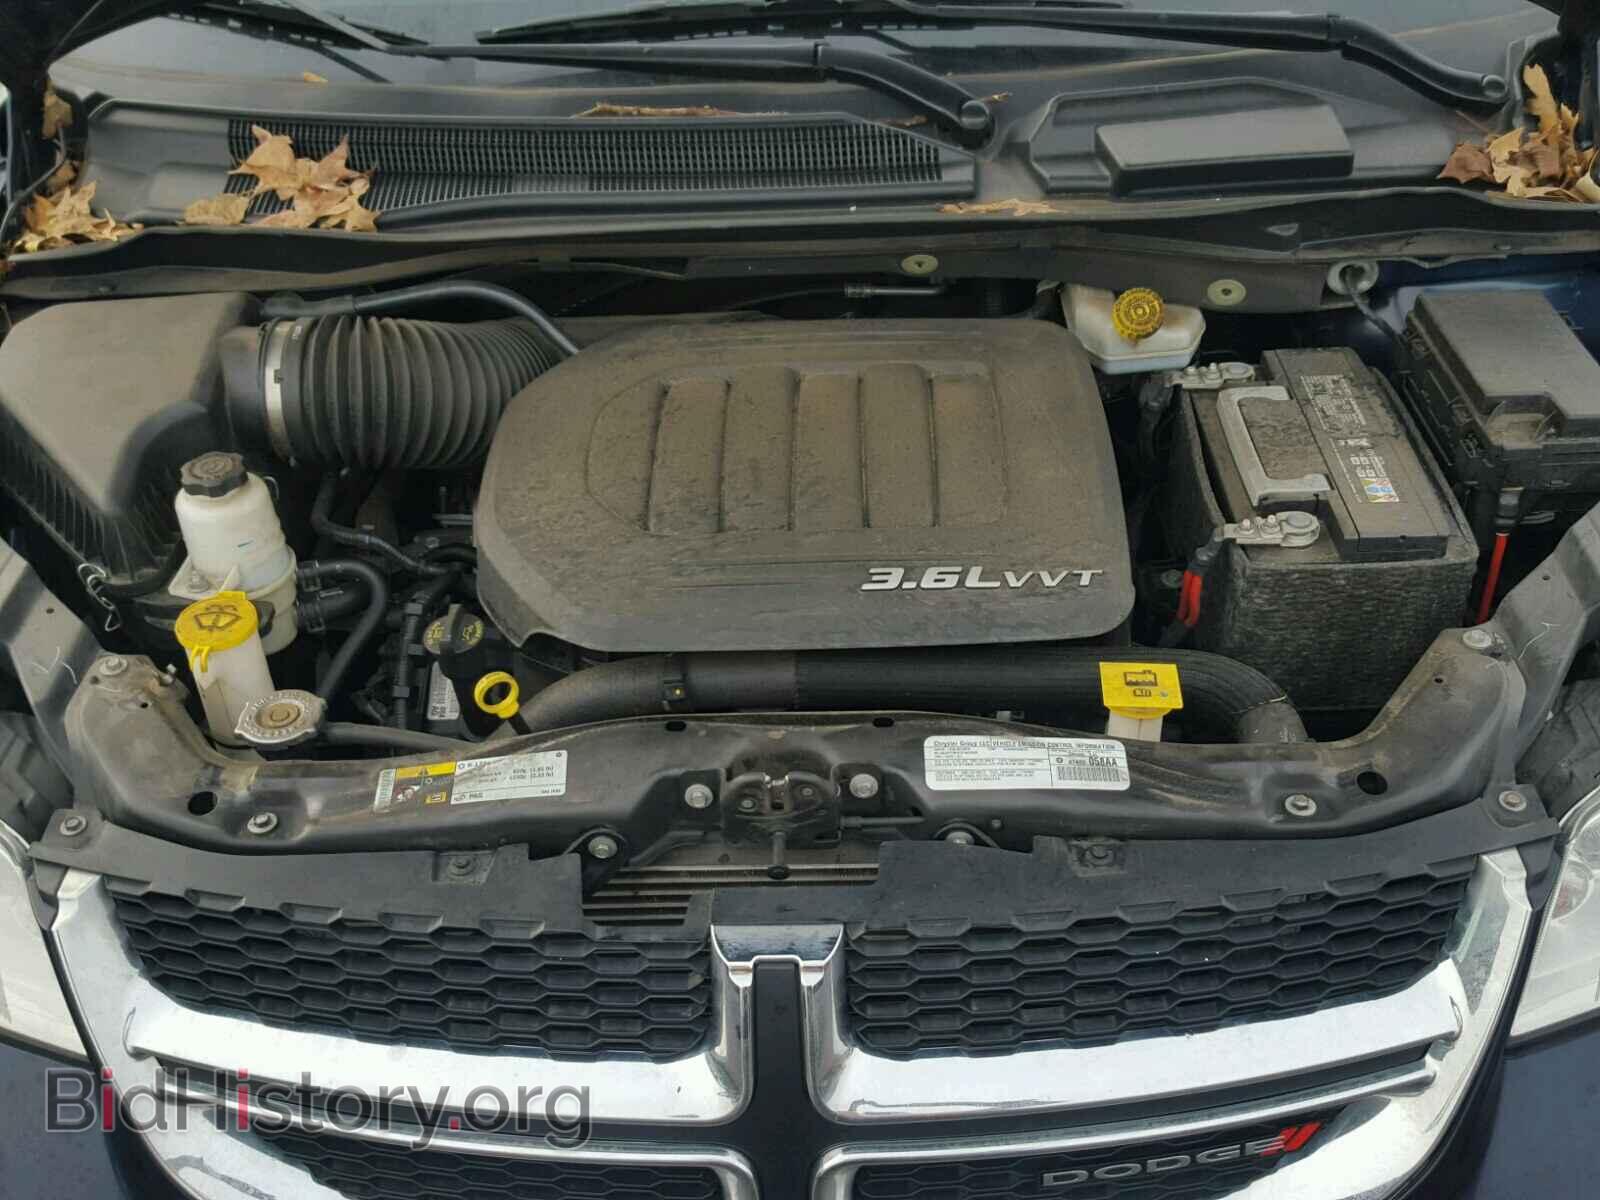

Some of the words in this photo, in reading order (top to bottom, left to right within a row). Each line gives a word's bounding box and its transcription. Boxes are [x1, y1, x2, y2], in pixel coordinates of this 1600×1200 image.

[861, 566, 1000, 591] 3.6L
[1003, 569, 1103, 588] VVT
[1042, 1135, 1286, 1187] DODGE
